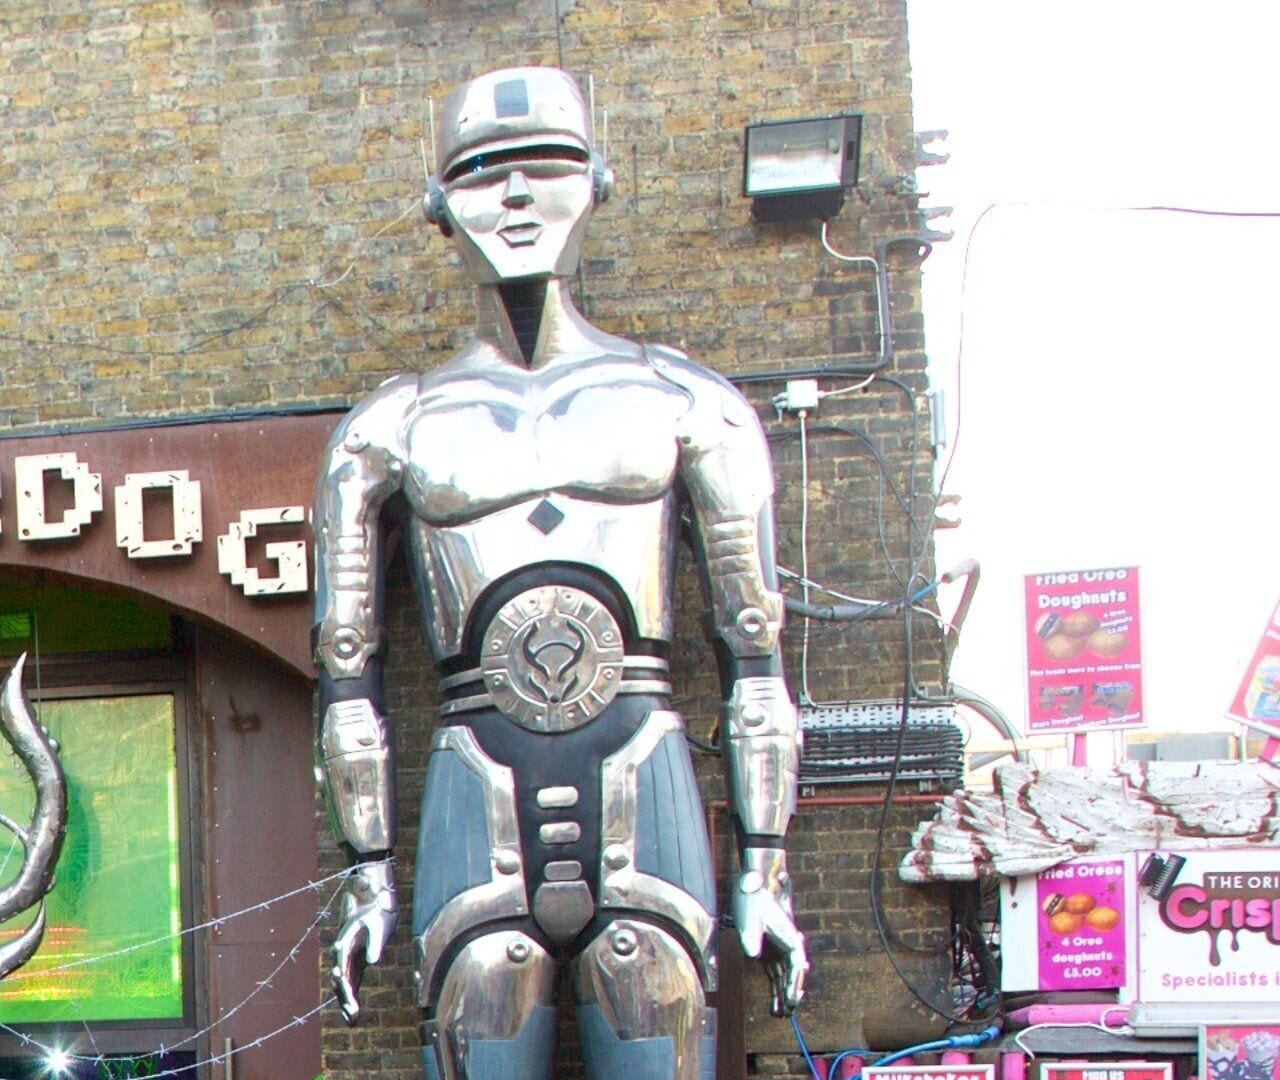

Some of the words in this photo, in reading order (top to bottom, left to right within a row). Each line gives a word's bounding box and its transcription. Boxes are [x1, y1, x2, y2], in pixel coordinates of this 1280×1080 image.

[1037, 589, 1128, 609] Doughnuts
[1076, 863, 1123, 879] Oreos
[1207, 875, 1244, 889] THE
[1061, 936, 1071, 947] 4
[1072, 936, 1104, 947] Oreo
[1051, 950, 1113, 965] doughnuts
[1161, 972, 1269, 990] Specialists
